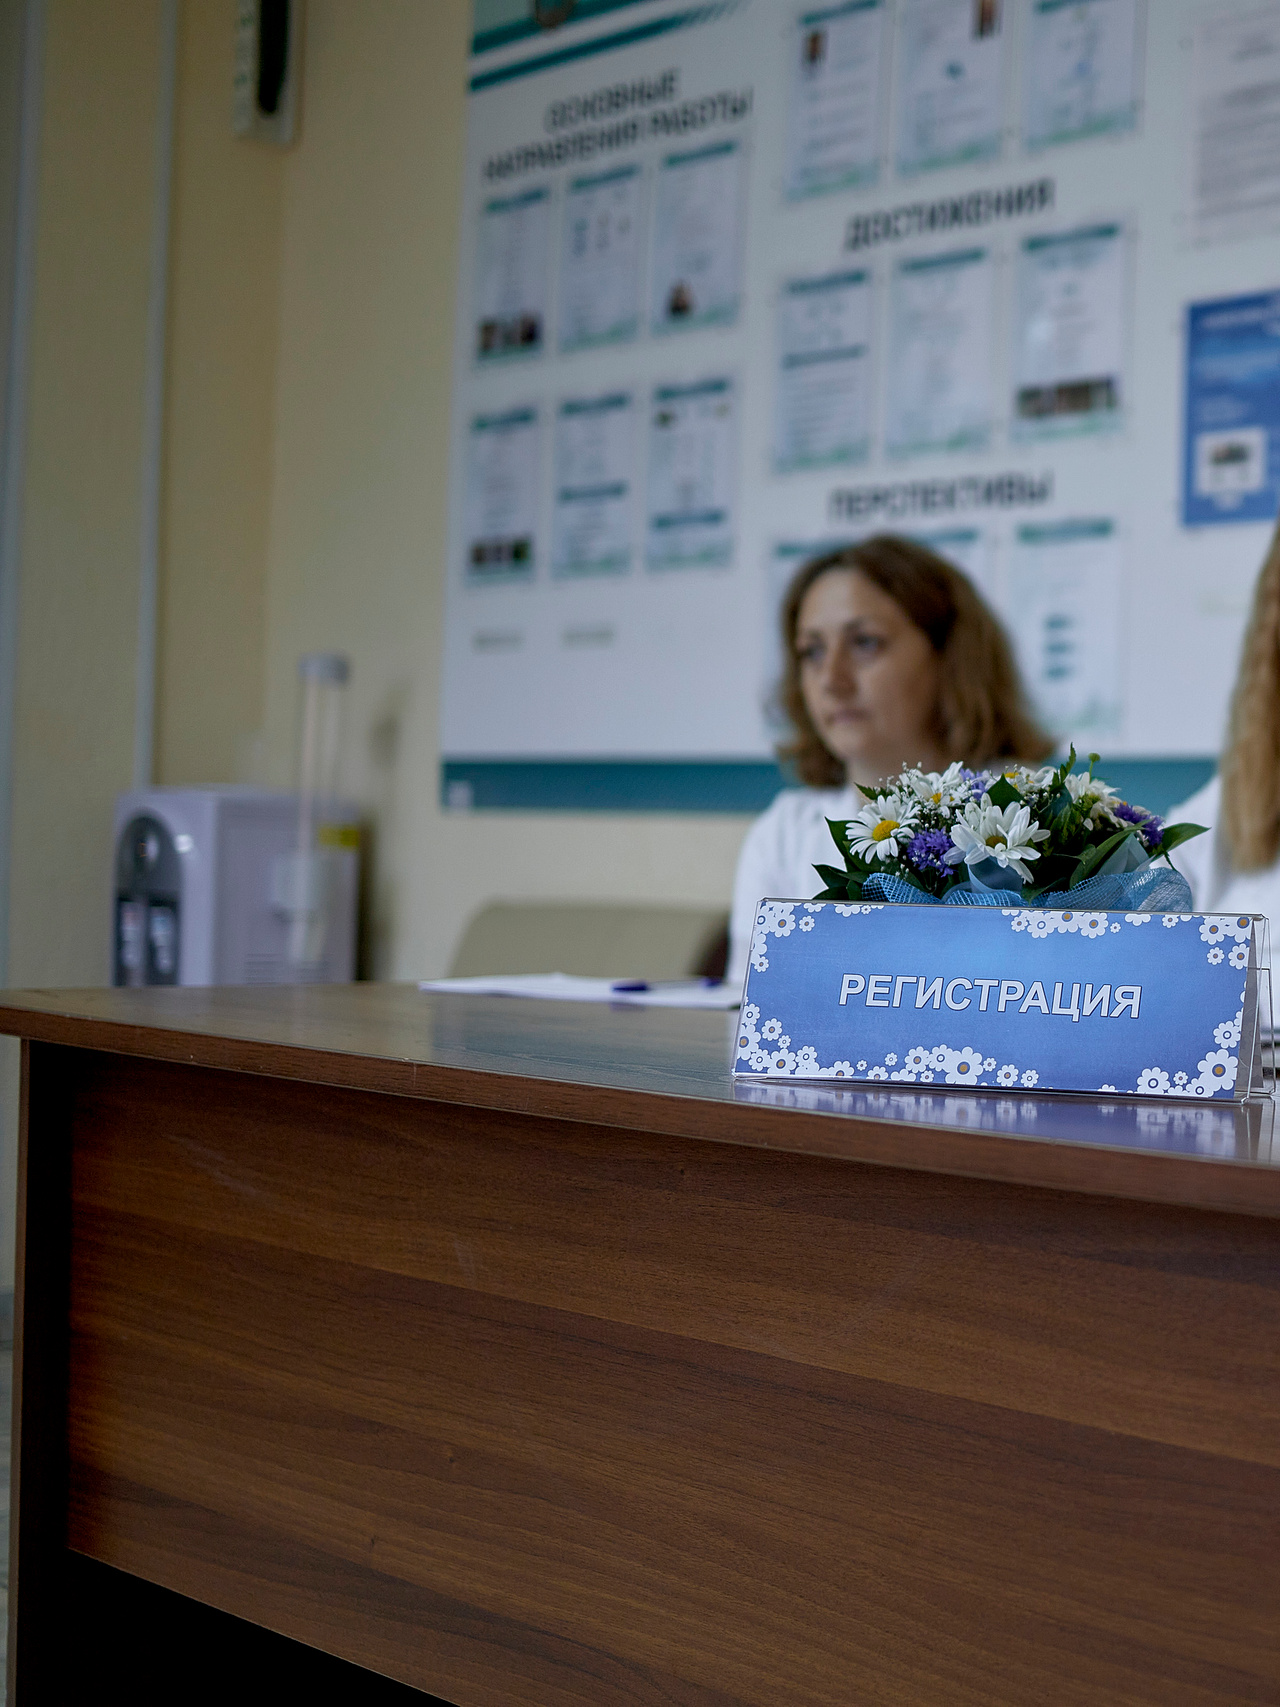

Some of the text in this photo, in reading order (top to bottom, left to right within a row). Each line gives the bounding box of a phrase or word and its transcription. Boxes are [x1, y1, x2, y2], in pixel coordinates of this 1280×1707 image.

[484, 116, 639, 179] НАПРАВЛЕНИЯ
[651, 85, 753, 136] РАБОТЫ
[545, 68, 678, 133] ОСНОВНЫЕ
[844, 178, 1055, 250] ДОСТИЖЕНИЯ
[829, 470, 1055, 522] ПЕРСПЕКТИВЫ
[838, 973, 1142, 1022] РЕГИСТРАЦИЯ
